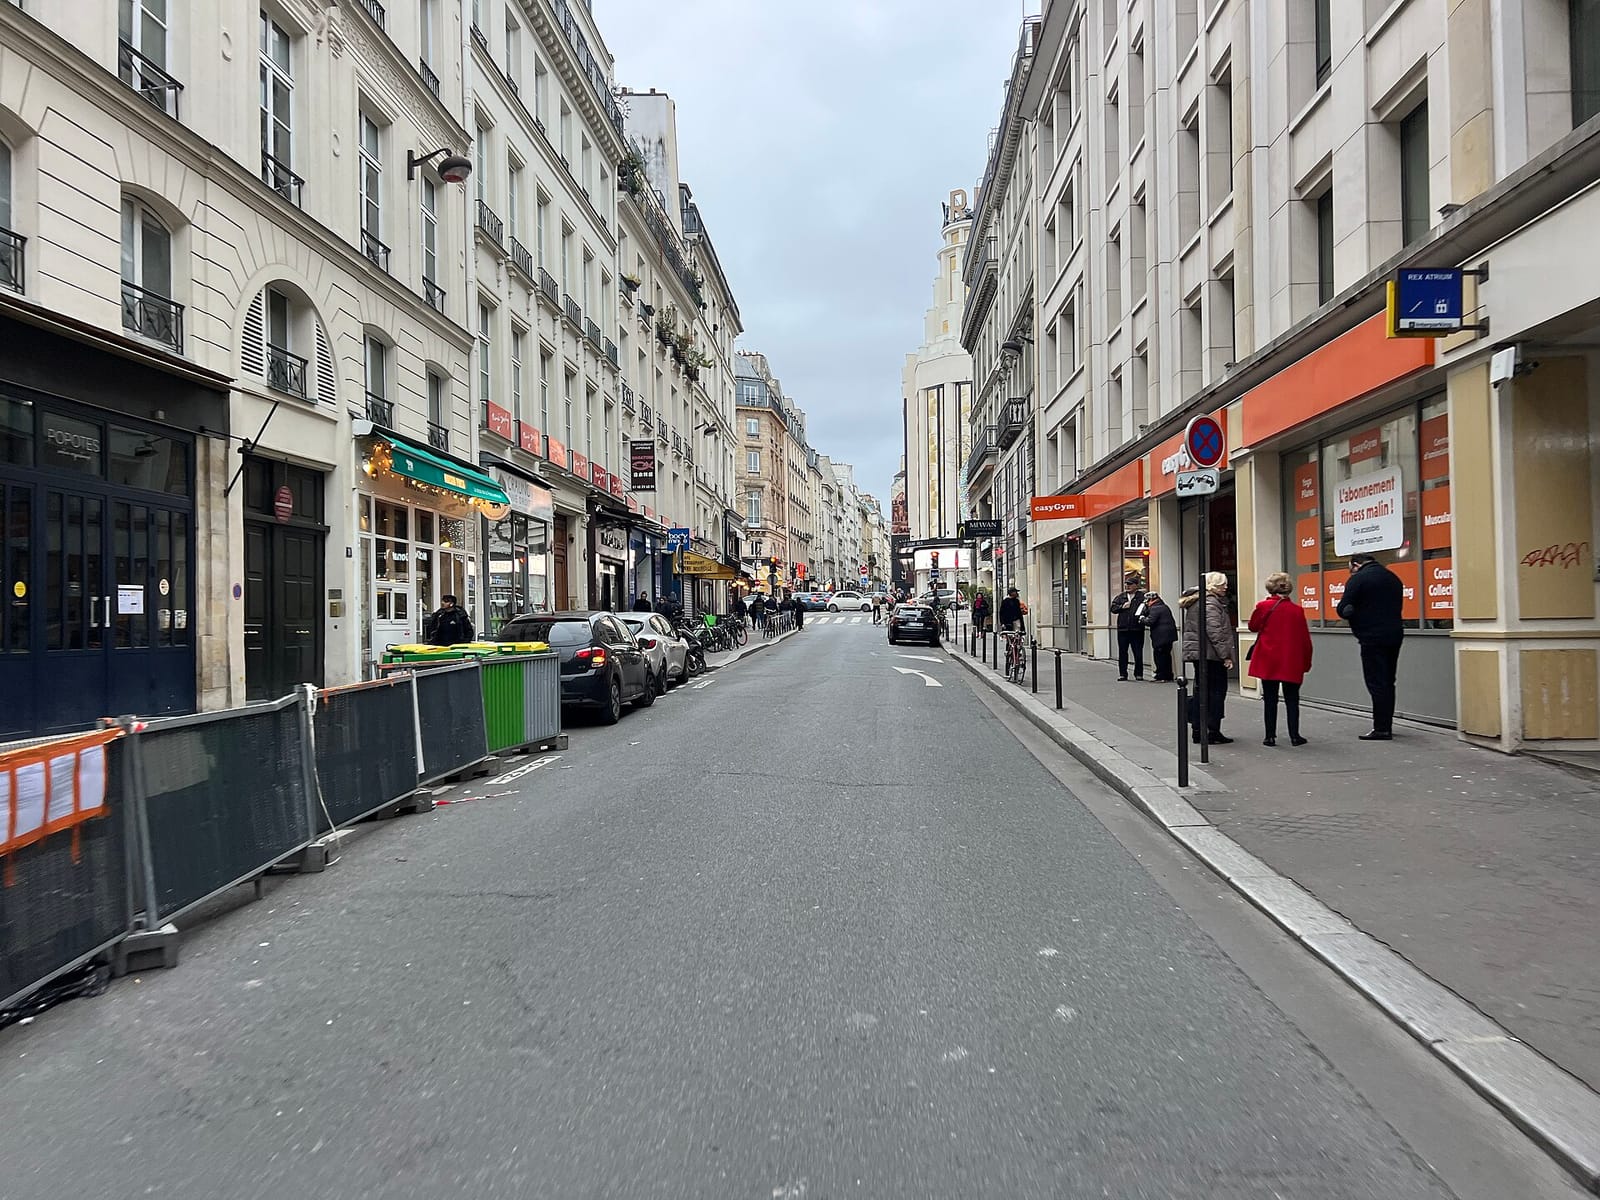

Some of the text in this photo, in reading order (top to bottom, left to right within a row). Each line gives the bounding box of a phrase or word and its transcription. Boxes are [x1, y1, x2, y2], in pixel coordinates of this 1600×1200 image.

[1407, 273, 1453, 281] REX ATRIUM
[47, 428, 101, 453] POPOTES
[1339, 475, 1395, 503] L'abonnement
[1034, 503, 1075, 512] easyGym
[1341, 507, 1365, 525] fitness
[1366, 500, 1390, 520] malin
[1301, 536, 1316, 548] Cardio
